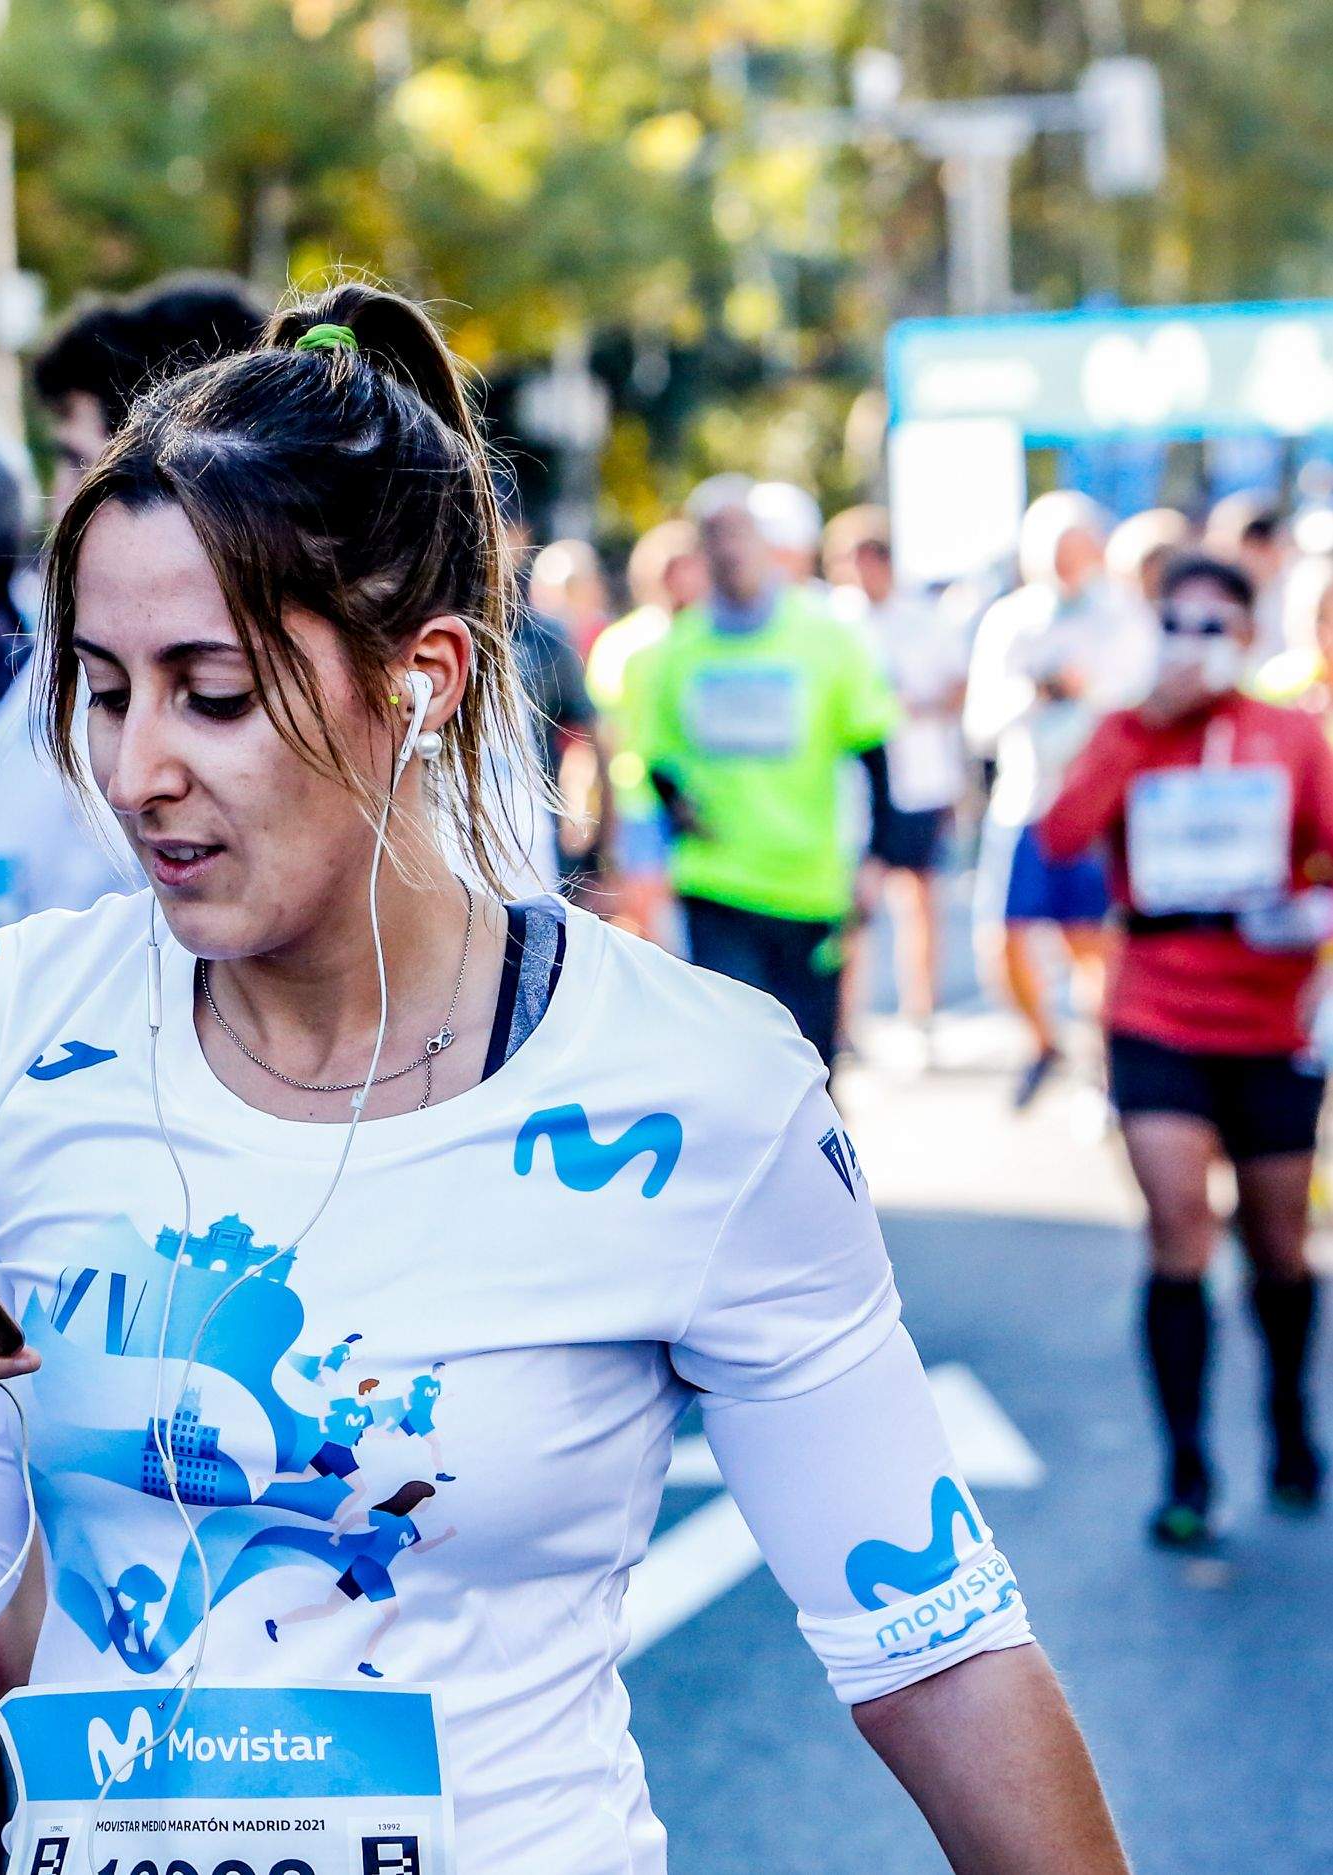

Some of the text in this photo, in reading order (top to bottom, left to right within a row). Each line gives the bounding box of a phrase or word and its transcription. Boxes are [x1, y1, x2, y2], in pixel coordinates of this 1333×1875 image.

[876, 1553, 1008, 1649] movista
[167, 1725, 333, 1762] Movistar
[94, 1816, 326, 1832] MOVISTAR MEDIO MARATÓN MADRID 2021
[377, 1823, 401, 1831] 13992
